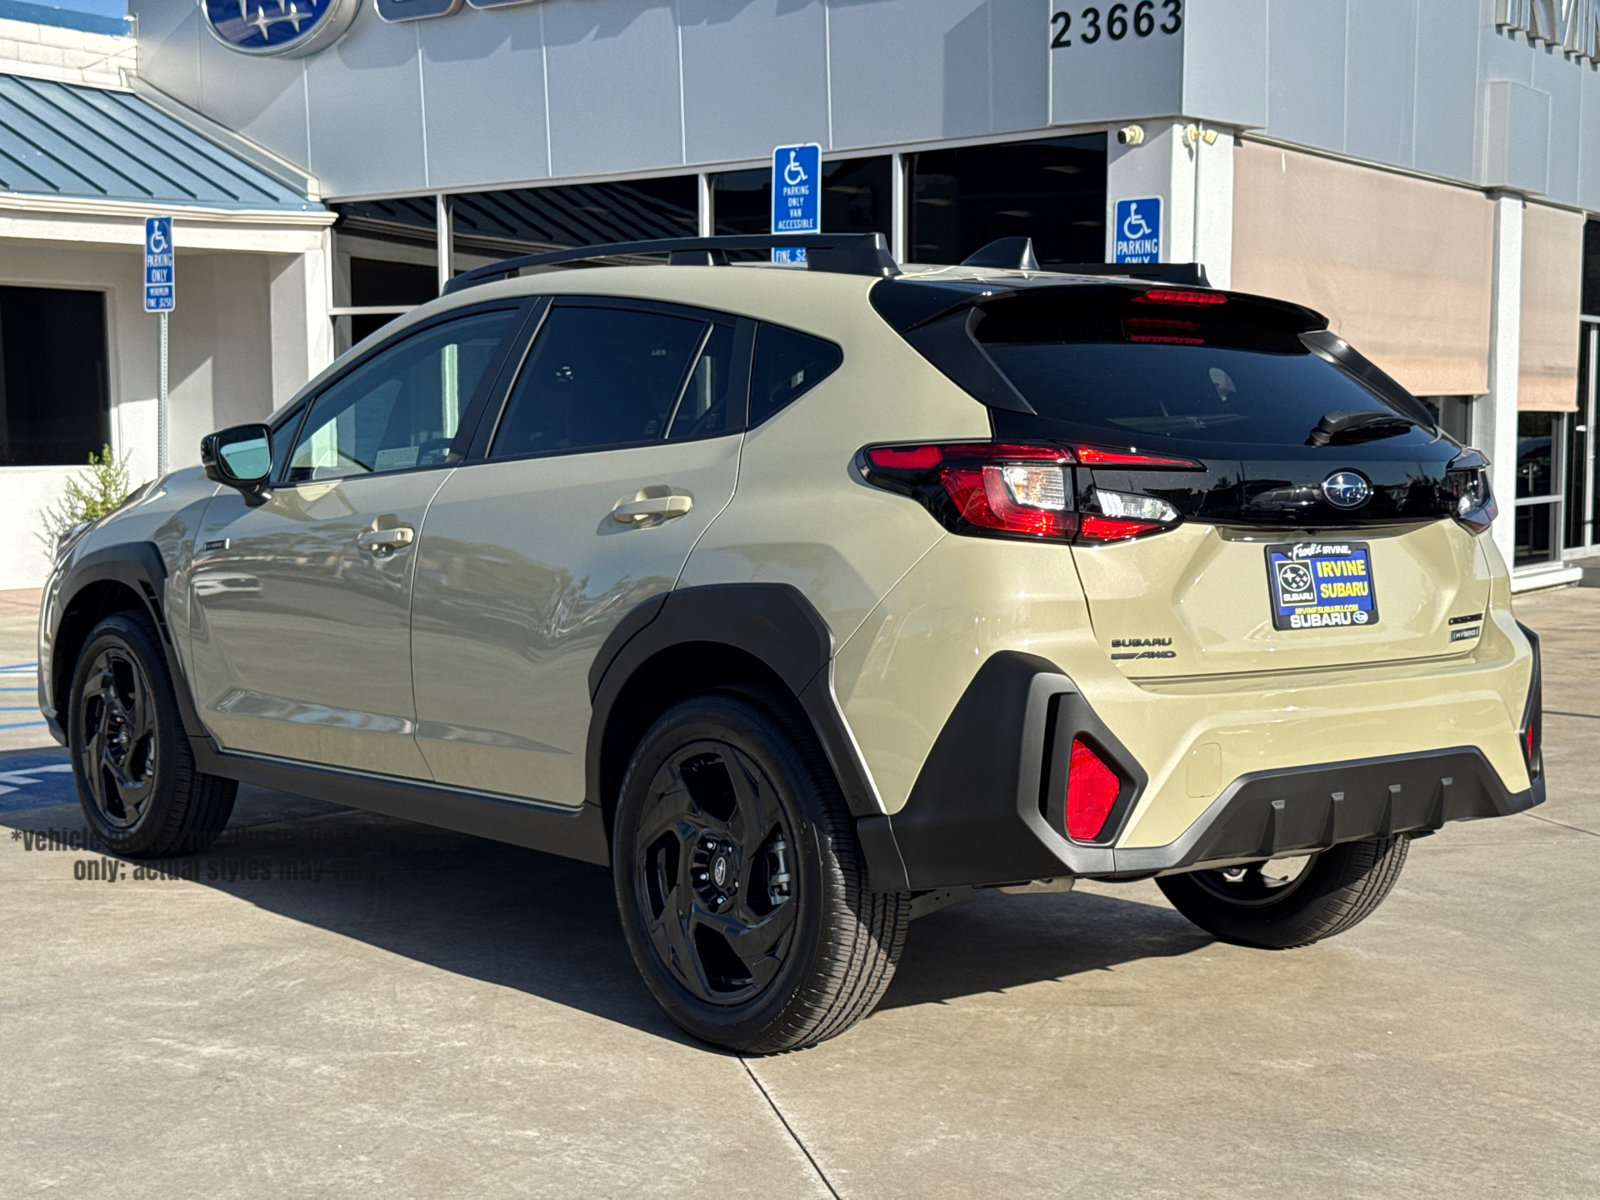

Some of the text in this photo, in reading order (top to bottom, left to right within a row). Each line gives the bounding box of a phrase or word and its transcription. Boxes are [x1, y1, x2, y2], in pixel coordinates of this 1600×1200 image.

[1050, 0, 1182, 49] 23663
[783, 186, 809, 196] PARKING
[788, 198, 804, 207] ONLY
[789, 208, 802, 218] VAN
[778, 219, 813, 229] ACCESSIBLE
[1117, 238, 1158, 256] PARKING
[147, 254, 172, 268] PARKING
[776, 251, 790, 262] FINE
[152, 269, 168, 282] ONLY
[1316, 560, 1367, 577] IRVINE
[1320, 582, 1368, 598] SUBARU
[1283, 593, 1313, 601] SUBARU
[1290, 613, 1351, 628] SUBARU
[1111, 637, 1173, 647] SUBARU
